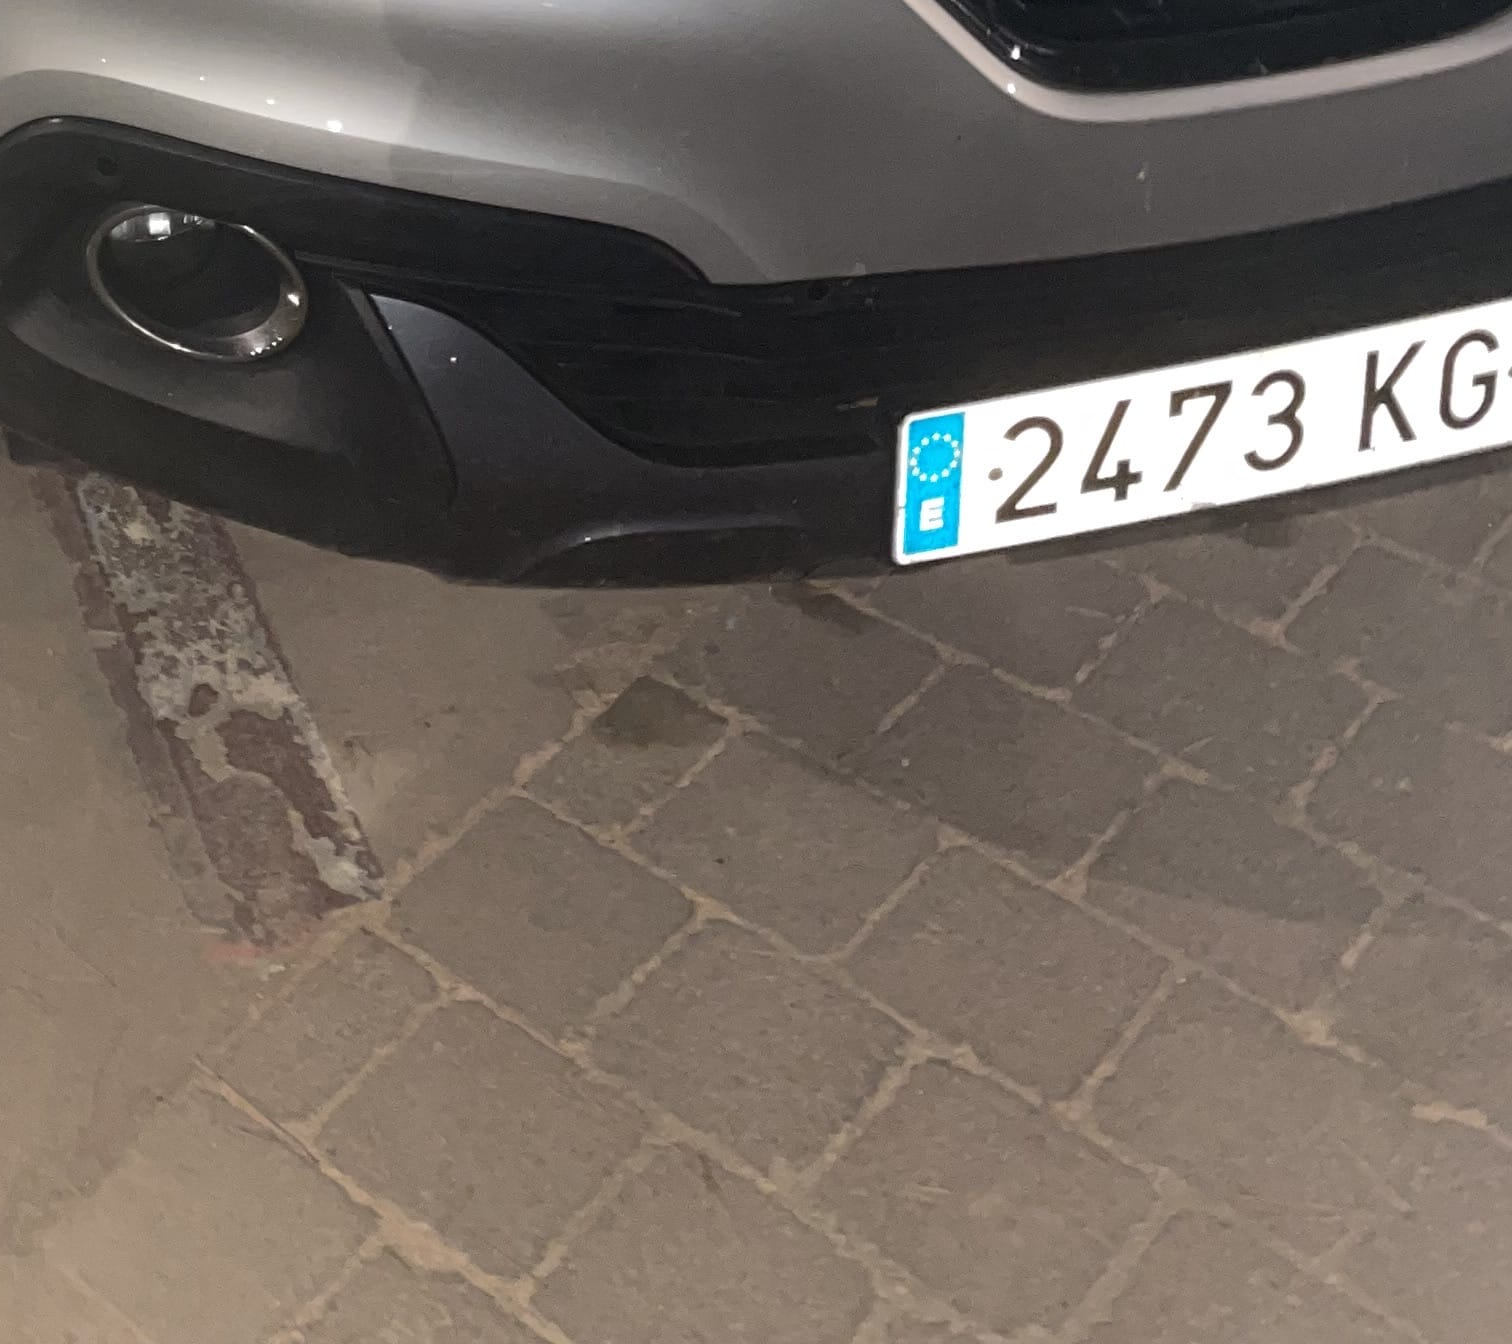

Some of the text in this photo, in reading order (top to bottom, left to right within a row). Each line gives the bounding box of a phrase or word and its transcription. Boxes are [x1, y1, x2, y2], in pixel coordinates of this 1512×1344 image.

[995, 328, 1512, 525] 2473 KG
[919, 495, 945, 532] E
